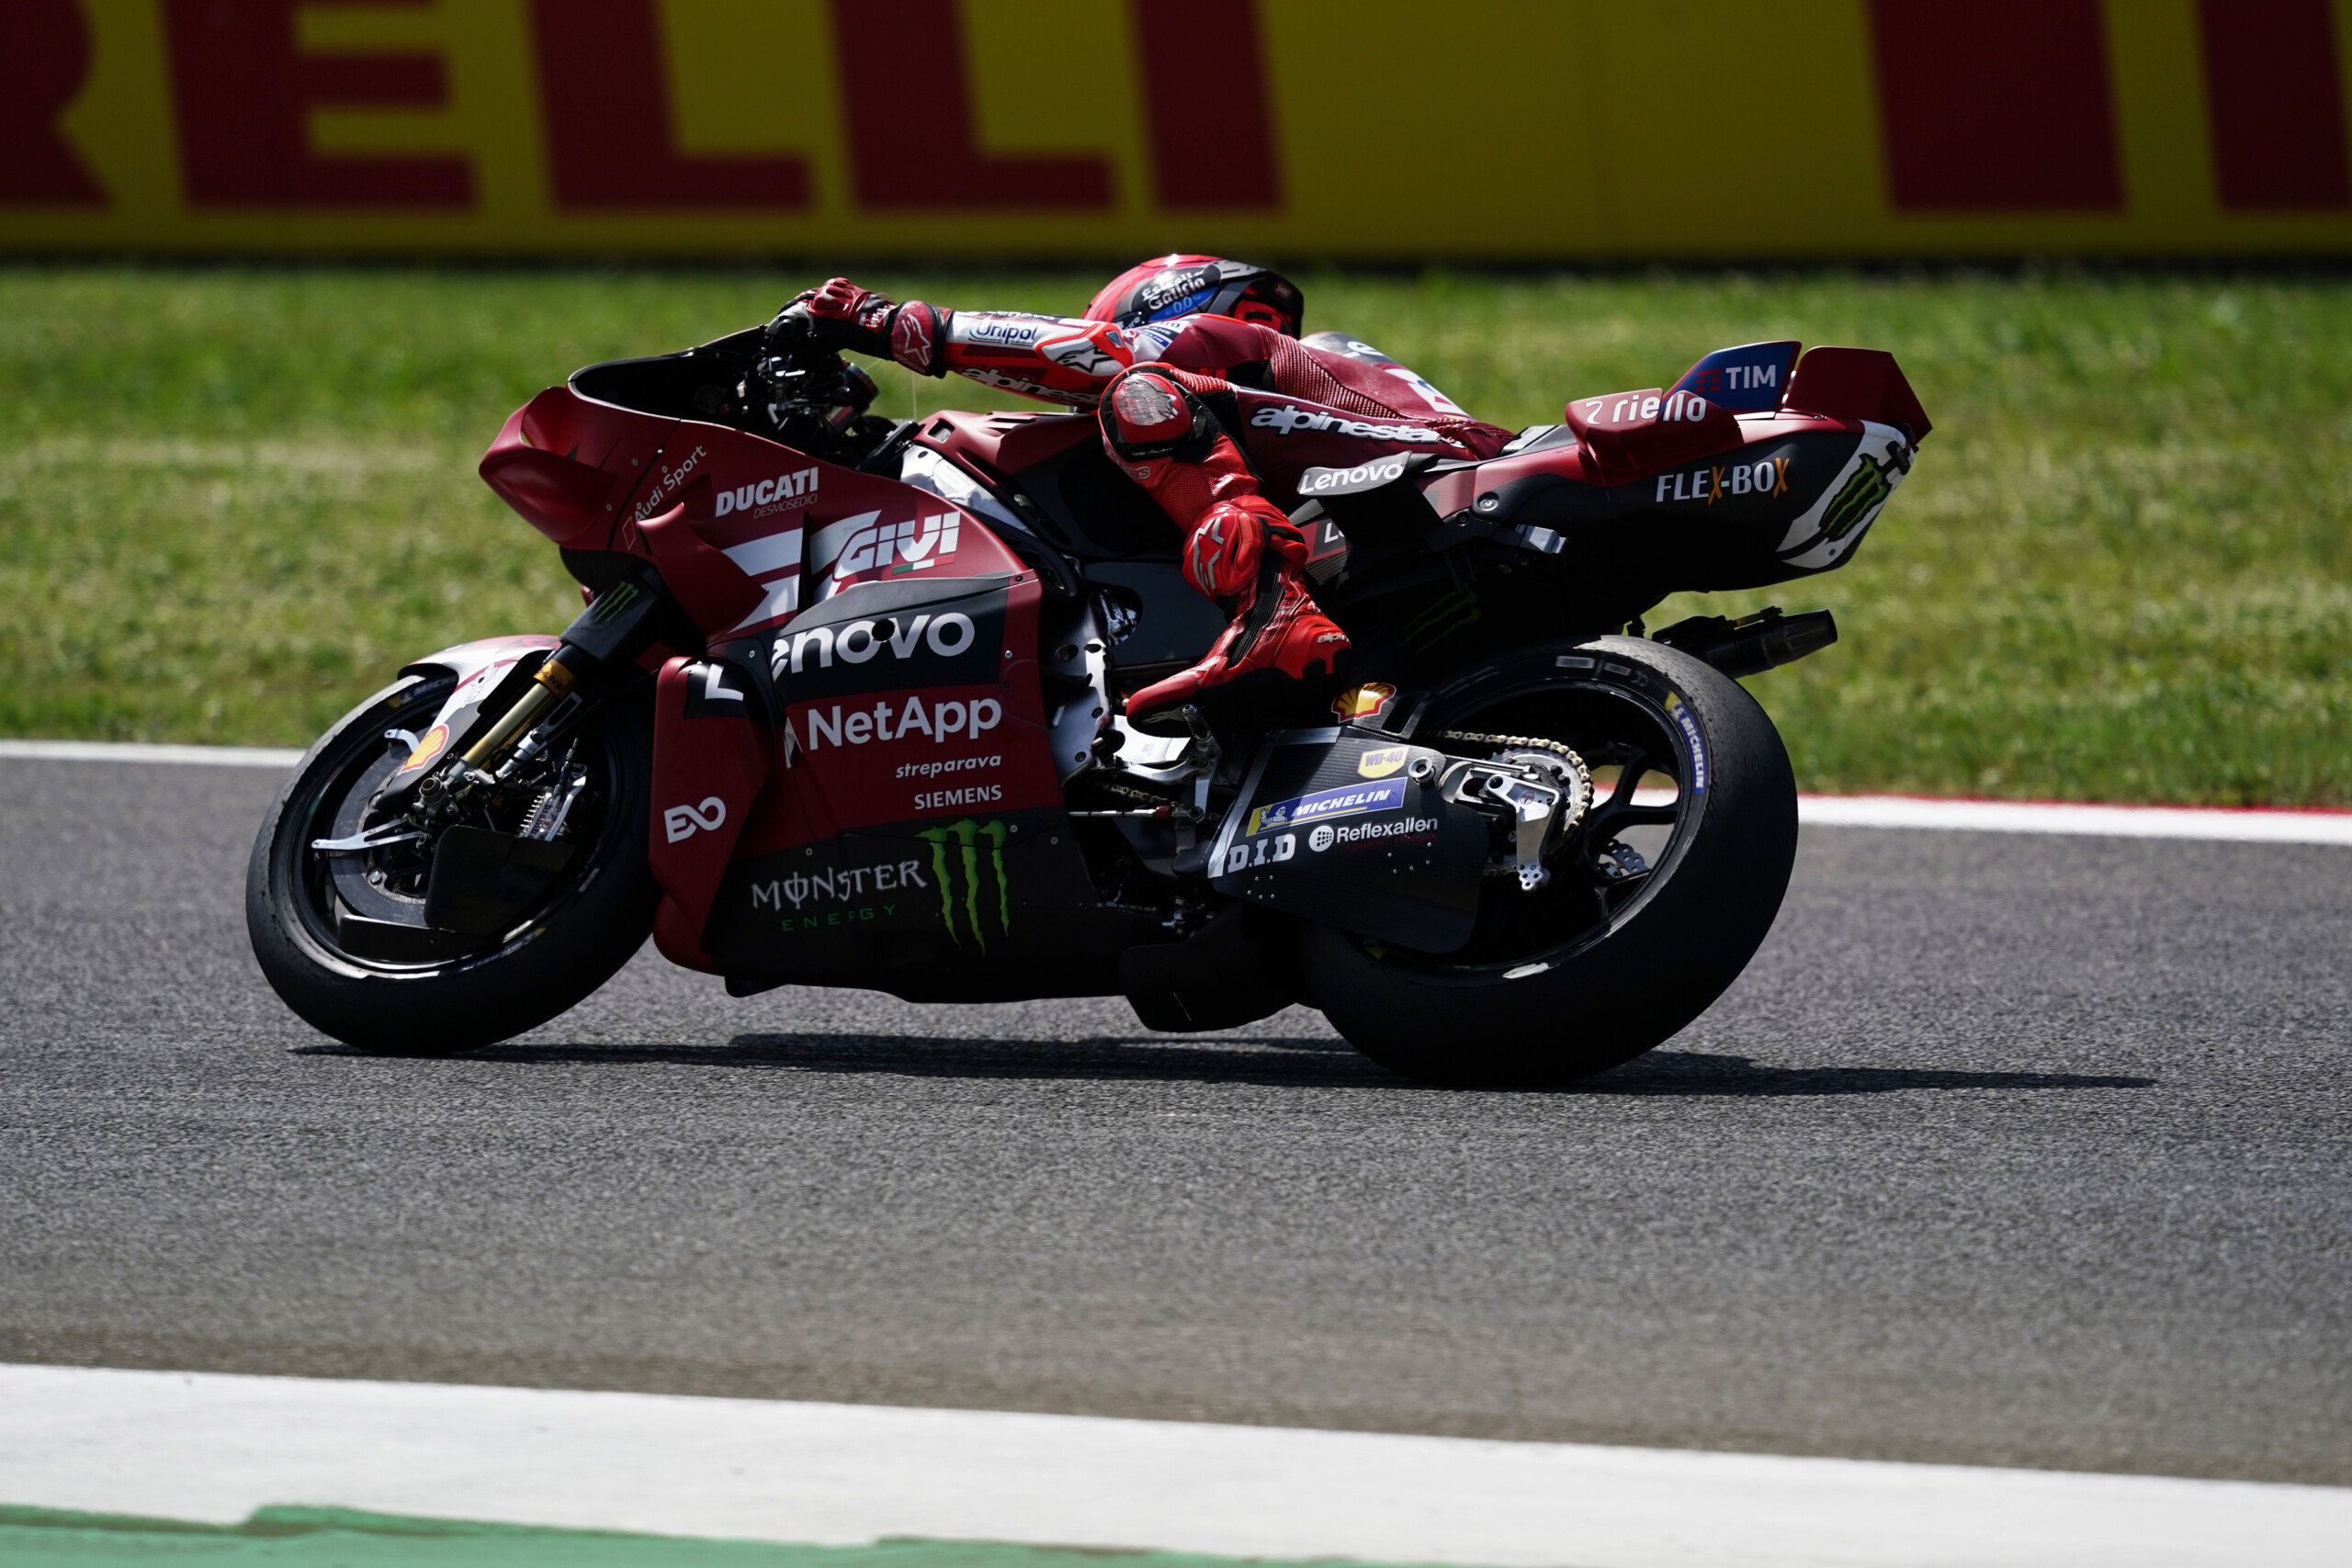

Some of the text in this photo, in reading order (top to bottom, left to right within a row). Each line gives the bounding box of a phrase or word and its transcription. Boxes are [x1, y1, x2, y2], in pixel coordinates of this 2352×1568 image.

[976, 320, 1039, 345] Unipol
[1725, 365, 1776, 390] TIM
[1611, 393, 1707, 423] riello
[635, 446, 707, 523] Audi Sport
[715, 467, 819, 517] DUCATI
[1299, 462, 1403, 495] Lenovo
[1656, 456, 1790, 506] FLEX-BOX
[753, 493, 818, 519] DESMOSEDICI
[834, 511, 960, 580] GIVI
[808, 695, 1002, 751] NetApp
[895, 754, 1001, 779] streparava
[1364, 750, 1405, 768] WD-40
[1680, 716, 1704, 788] MICHELIN
[914, 784, 1002, 809] SIEMENS
[1291, 789, 1392, 818] MICHELIN
[1336, 817, 1439, 843] Reflexallen
[1227, 833, 1296, 874] D.I.D
[750, 858, 929, 912] MONSTER
[781, 903, 897, 932] ENERGY
